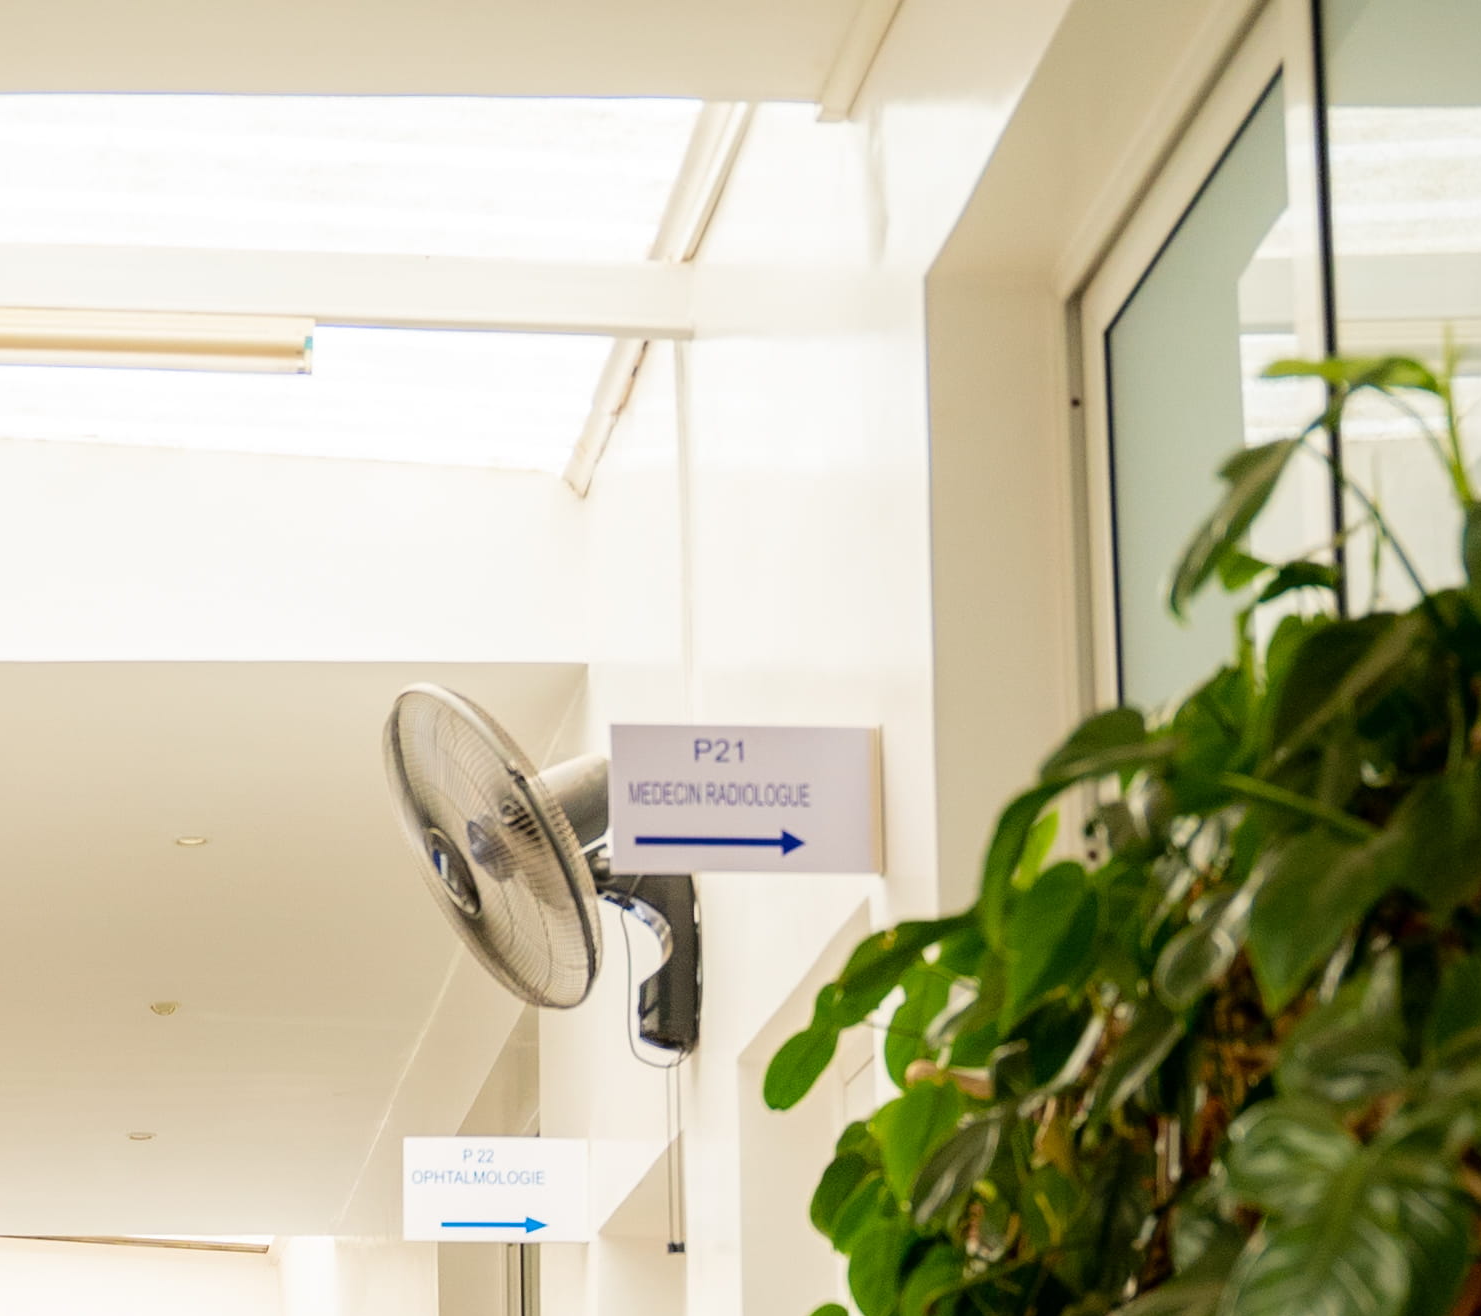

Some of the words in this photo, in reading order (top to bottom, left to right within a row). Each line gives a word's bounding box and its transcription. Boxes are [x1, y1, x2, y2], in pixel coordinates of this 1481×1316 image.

[693, 737, 745, 763] P21
[628, 781, 701, 806] MEDECIN
[704, 782, 811, 808] RADIOLOGUE
[463, 1149, 473, 1161] P
[478, 1150, 494, 1163] 22
[411, 1169, 546, 1186] OPHTALMOLOGIE
